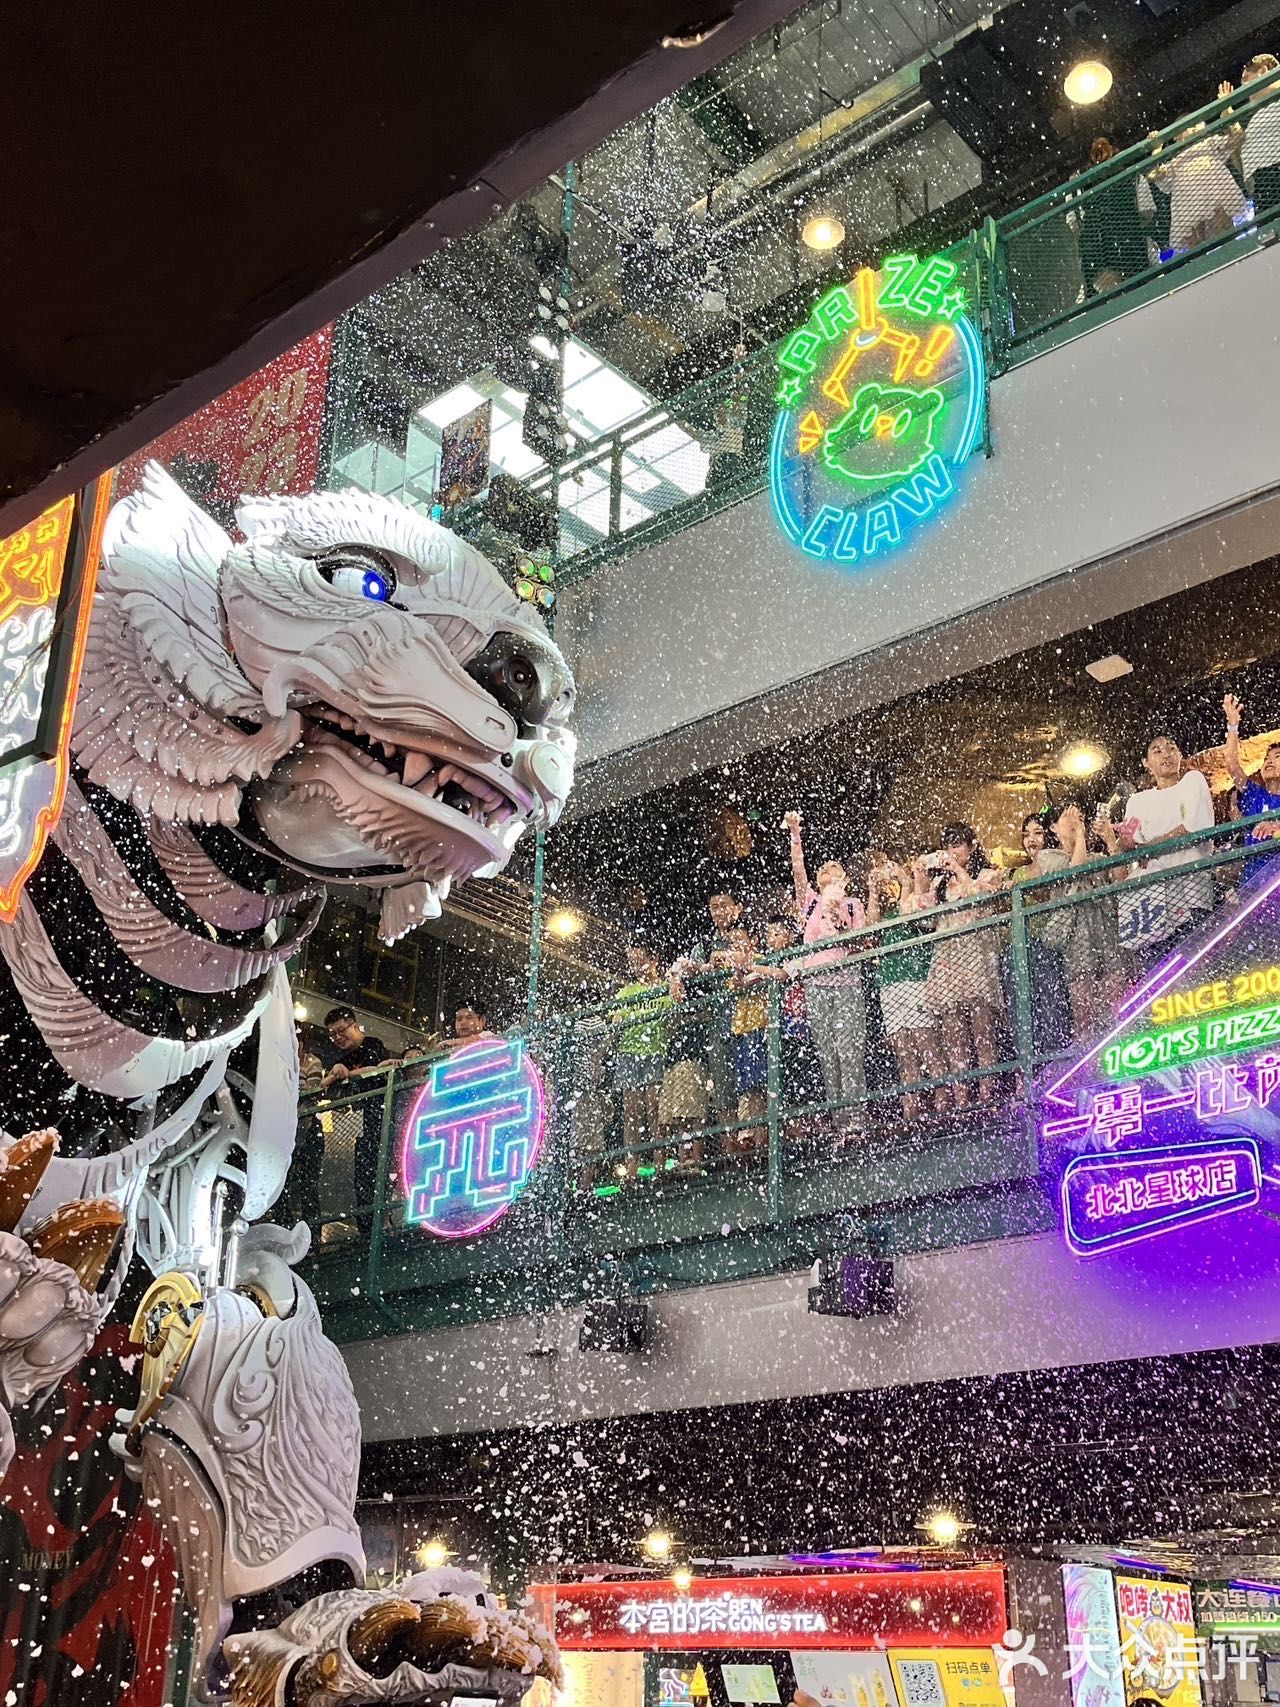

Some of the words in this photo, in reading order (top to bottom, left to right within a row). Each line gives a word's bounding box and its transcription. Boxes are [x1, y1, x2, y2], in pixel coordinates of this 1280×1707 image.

[779, 255, 957, 373] PRIZE
[801, 454, 953, 560] CLAW
[1150, 981, 1228, 1025] SINCE
[1085, 1159, 1237, 1220] 北北星球店
[618, 1597, 729, 1634] 本宮的茶
[729, 1599, 763, 1615] BEN
[945, 1660, 992, 1676] 扫码点单
